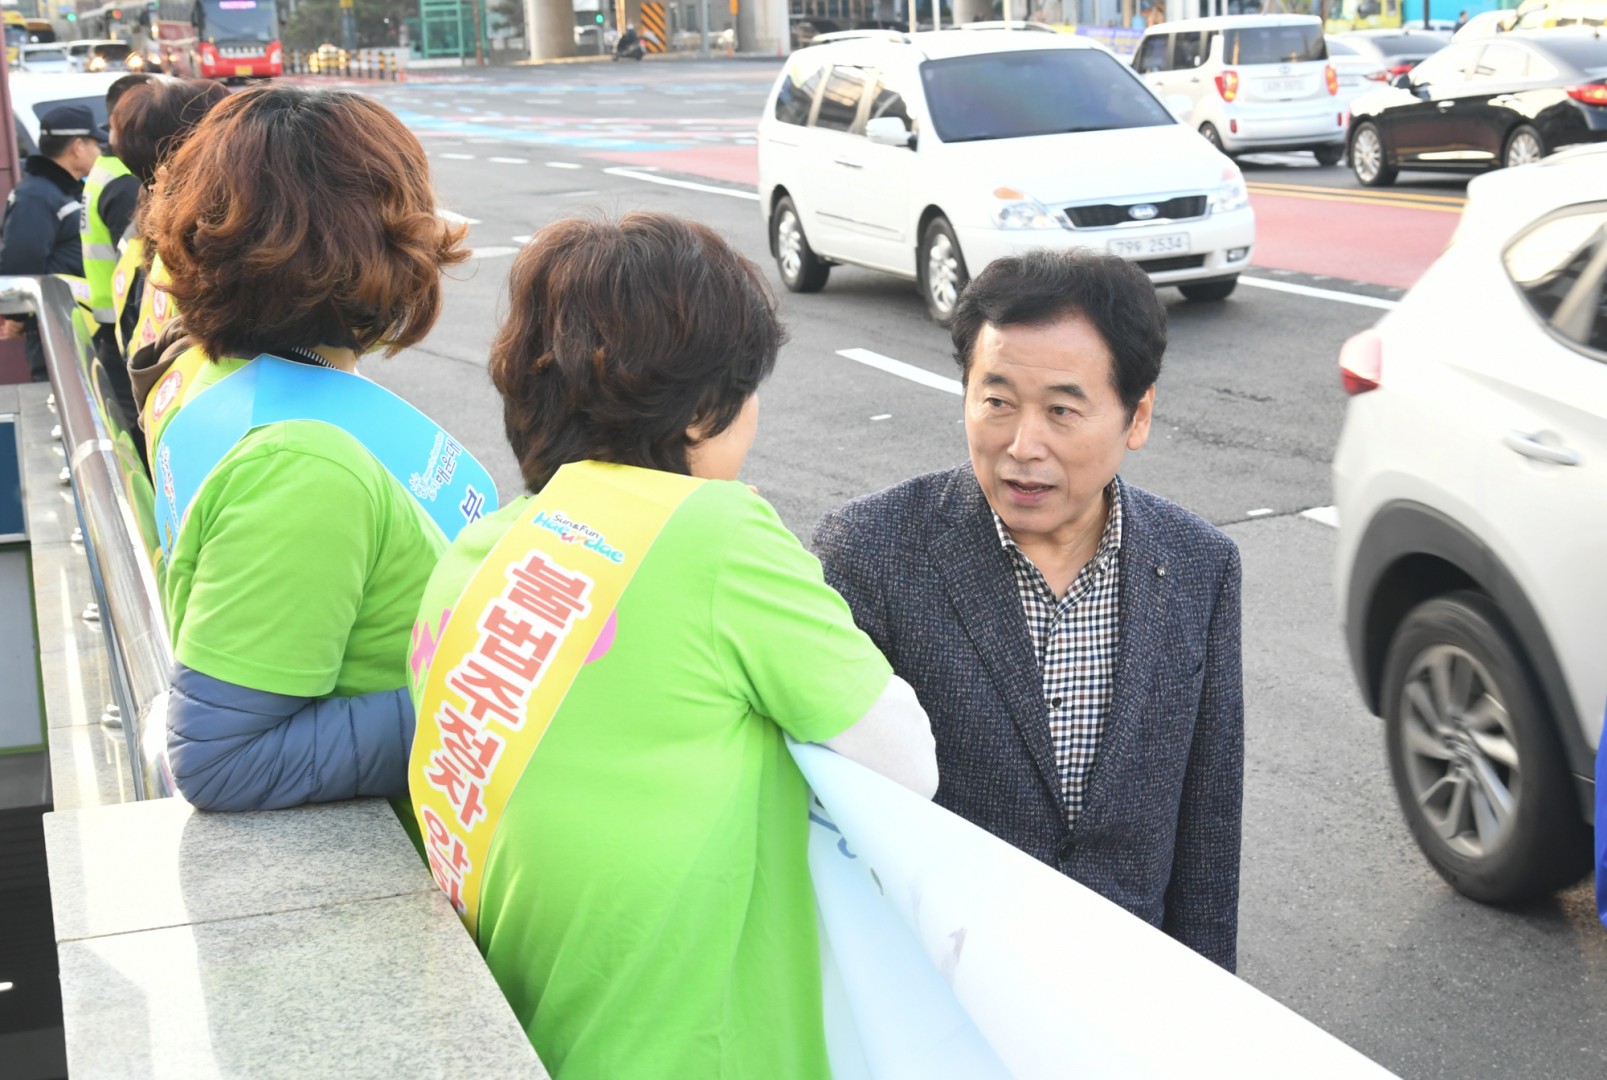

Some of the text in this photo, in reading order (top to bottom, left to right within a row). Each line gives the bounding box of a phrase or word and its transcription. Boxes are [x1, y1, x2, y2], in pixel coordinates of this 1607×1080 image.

[1149, 237, 1182, 252] 2534
[533, 511, 622, 562] Haeundae
[553, 514, 599, 538] Sun&Fun
[427, 554, 588, 827] 불법주정차
